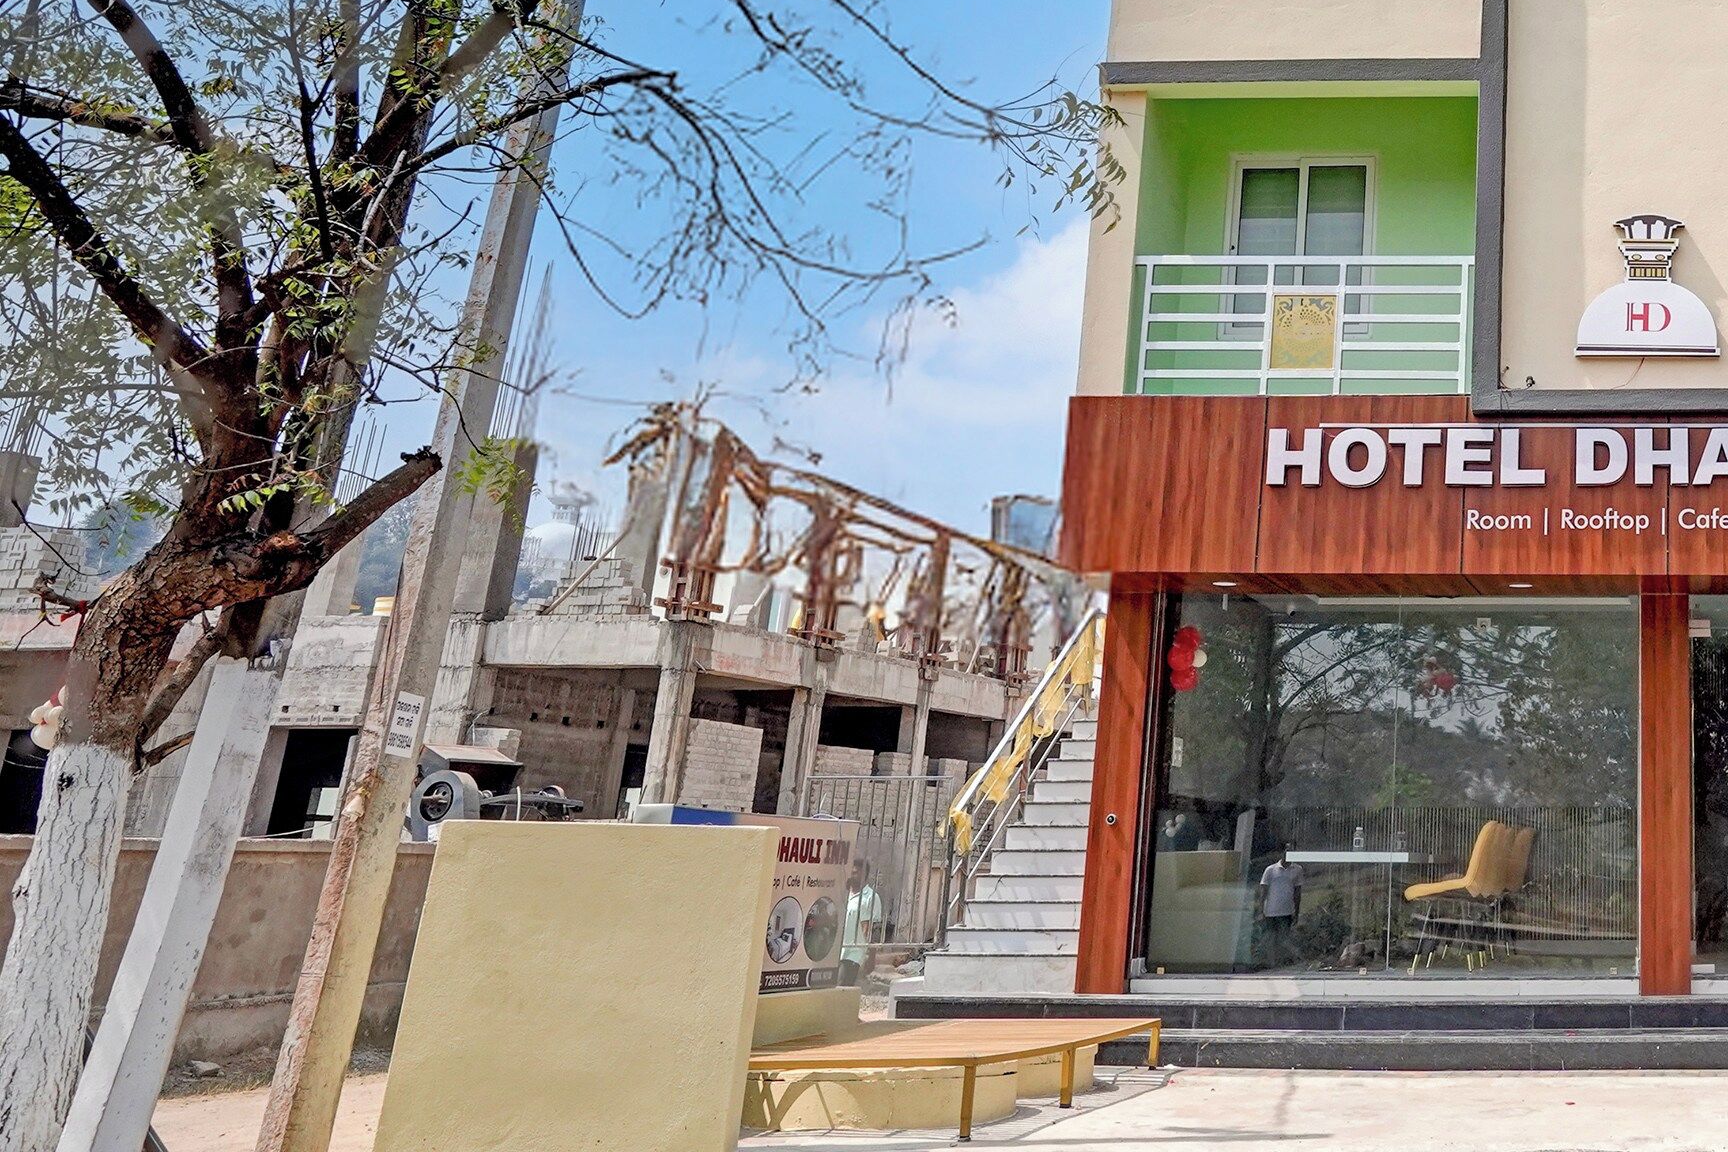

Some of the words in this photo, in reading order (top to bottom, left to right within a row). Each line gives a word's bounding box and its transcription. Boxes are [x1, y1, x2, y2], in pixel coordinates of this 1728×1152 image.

[1625, 302, 1671, 332] HD
[1265, 427, 1547, 488] HOTEL
[1466, 509, 1531, 531] Room
[1560, 508, 1650, 534] Rooftop
[777, 836, 823, 864] HAULI
